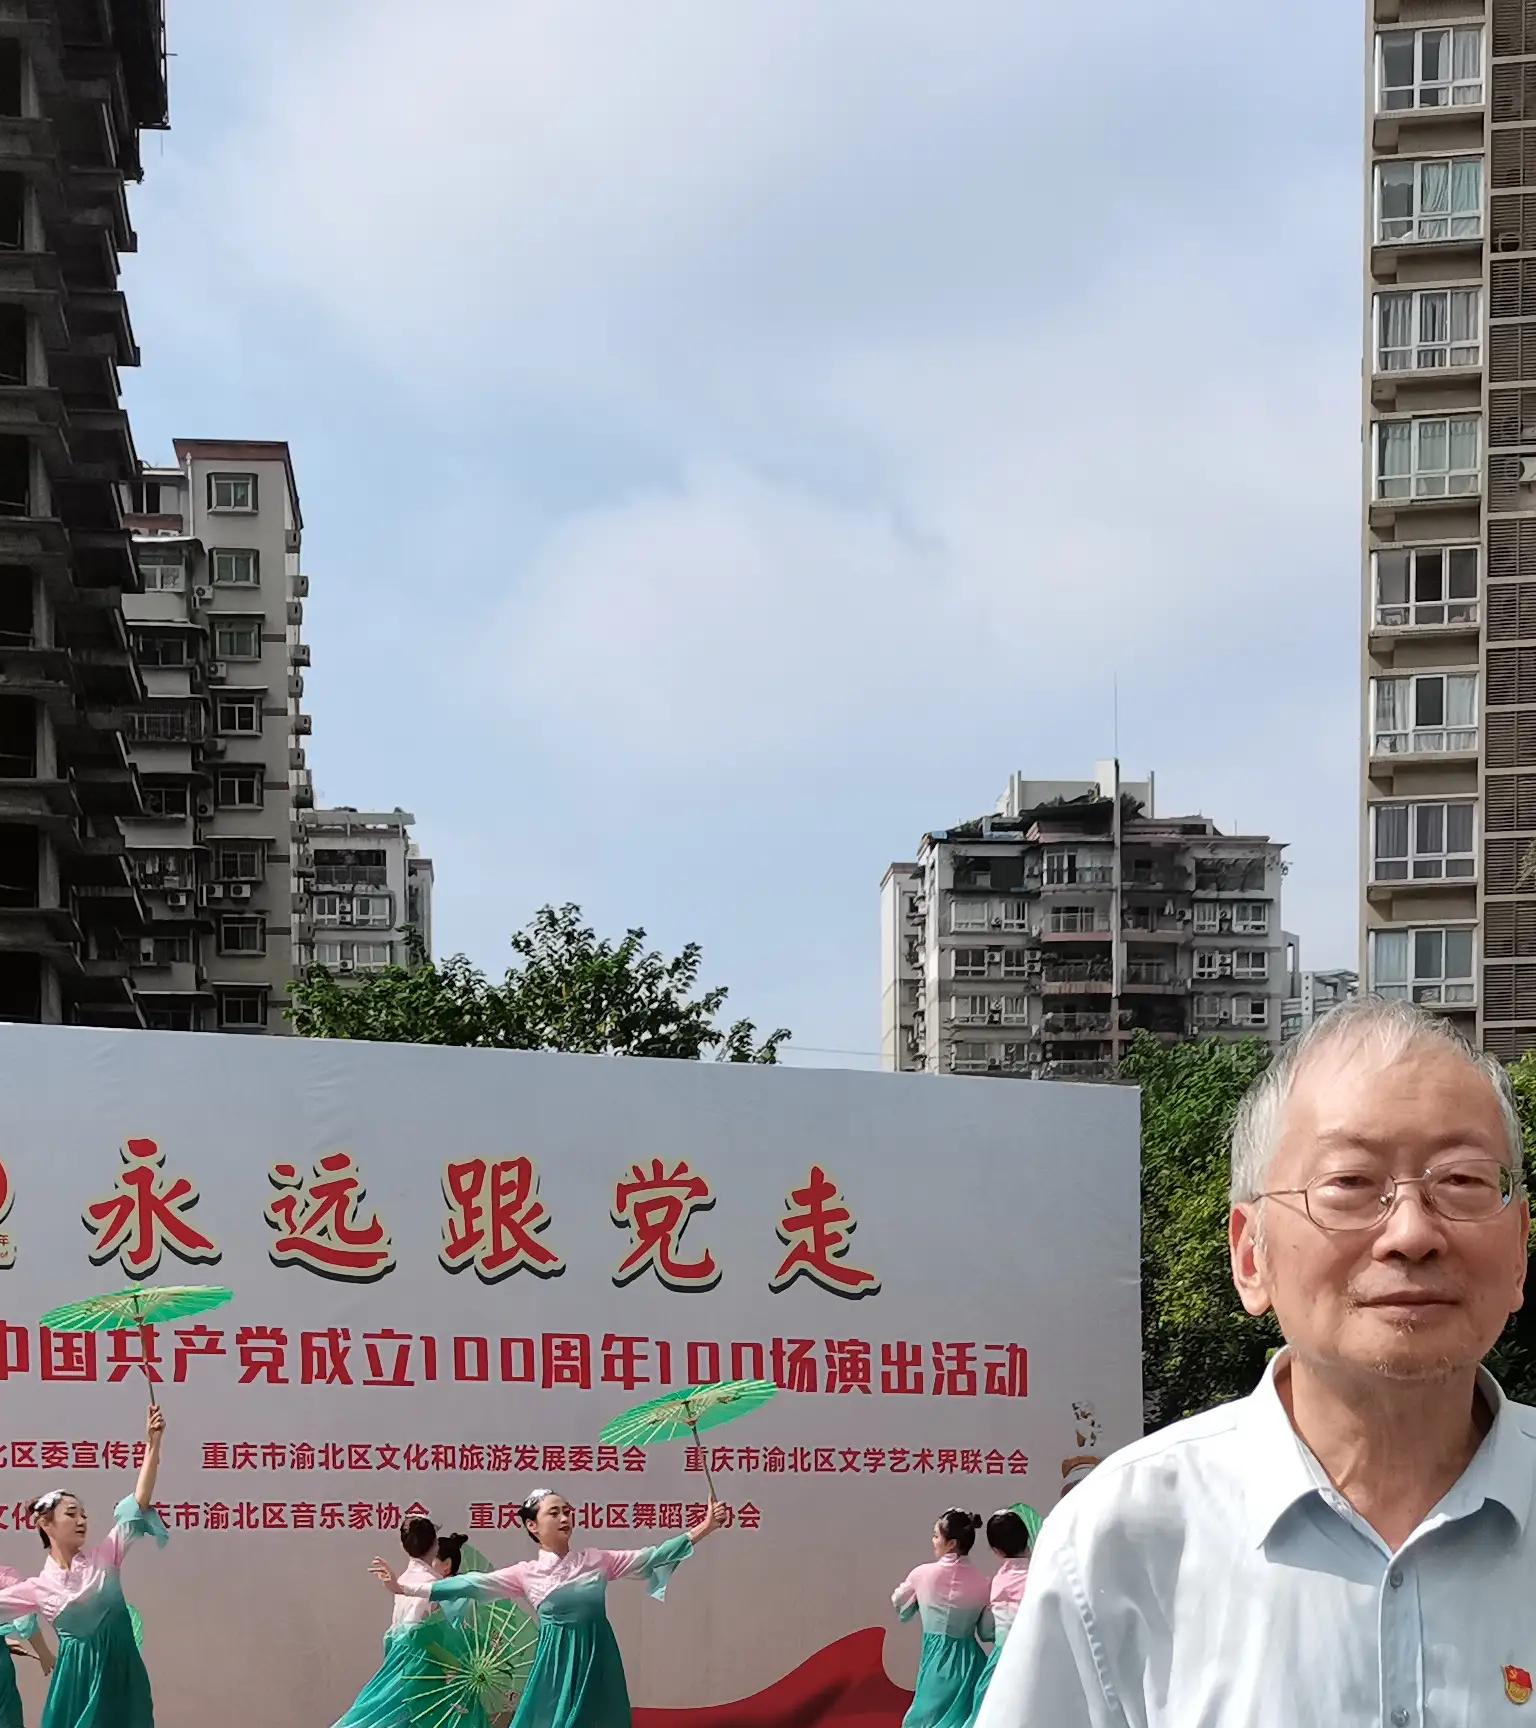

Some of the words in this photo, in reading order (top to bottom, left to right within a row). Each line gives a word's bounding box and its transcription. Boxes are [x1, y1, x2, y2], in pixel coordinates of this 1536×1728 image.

[86, 1138, 876, 1290] 永远跟党走
[201, 1441, 647, 1473] 重庆市渝北区文化和旅游发展委员会
[683, 1446, 1030, 1475] 重庆市渝北区文学艺术界联合会
